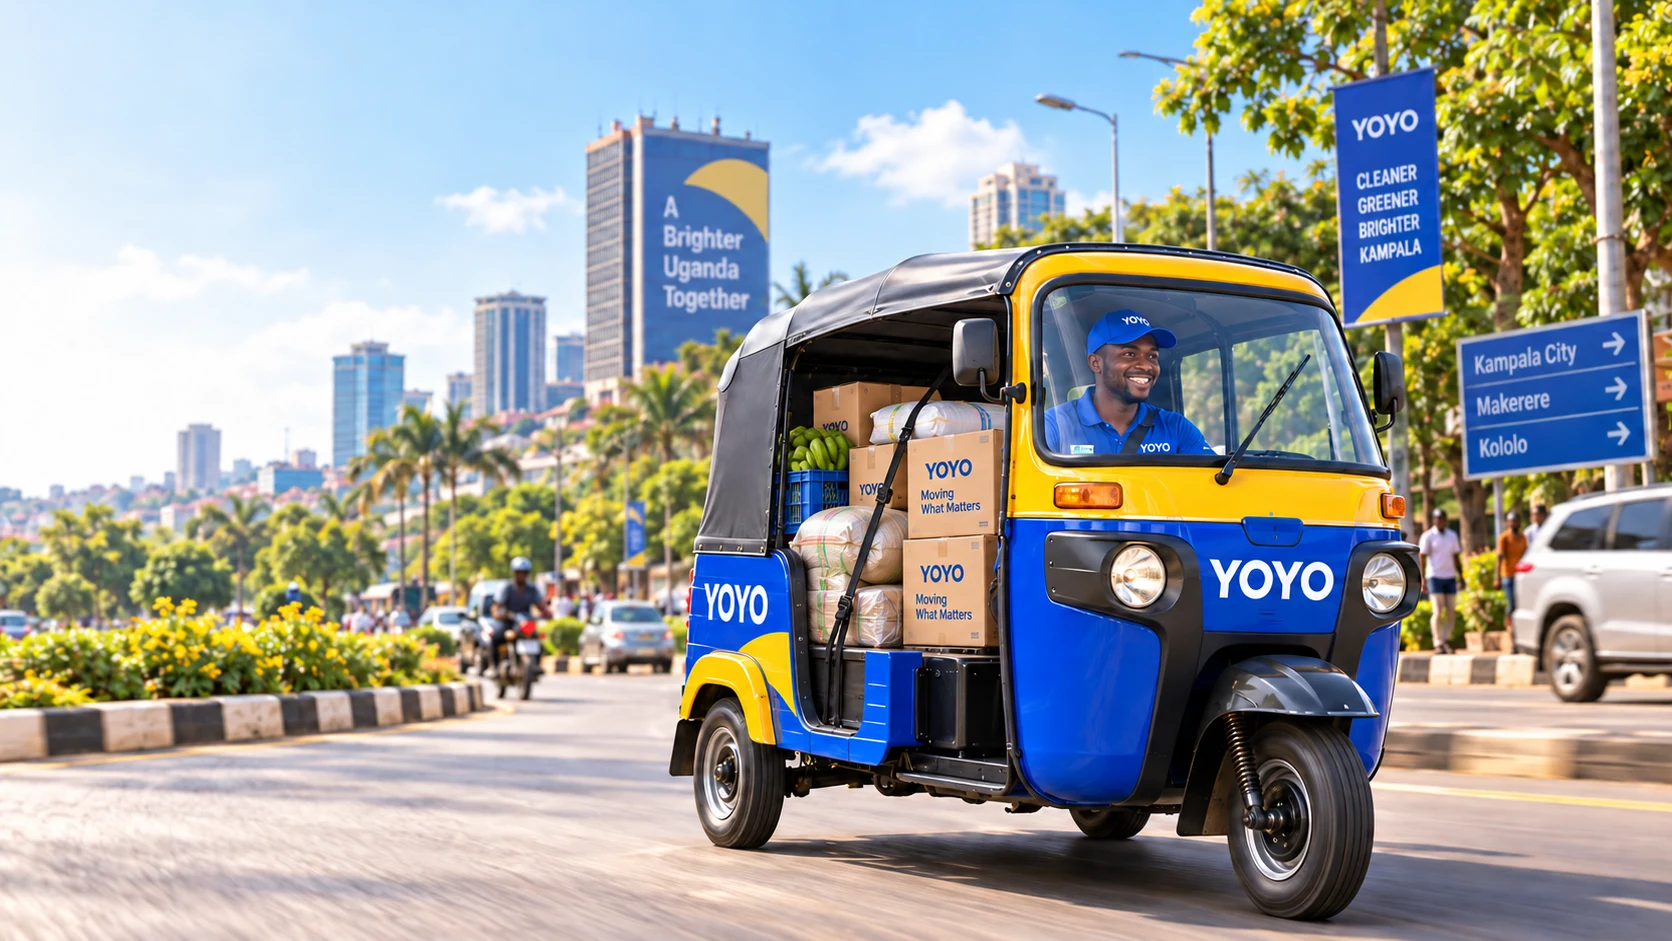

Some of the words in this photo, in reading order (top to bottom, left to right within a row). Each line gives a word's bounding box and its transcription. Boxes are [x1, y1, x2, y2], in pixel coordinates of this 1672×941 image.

[1352, 109, 1418, 141] YOYO
[1356, 164, 1417, 190] CLEANER
[663, 196, 678, 218] A
[1357, 189, 1418, 215] GREENER
[1358, 213, 1420, 239] BRIGHTER
[663, 225, 744, 254] Brighter
[1359, 238, 1422, 264] KAMPALA
[663, 254, 740, 283] Uganda
[663, 285, 750, 314] Together
[1121, 315, 1150, 327] YOYO
[1474, 347, 1542, 377] Kampala
[1544, 342, 1577, 367] City
[1476, 393, 1550, 417] Makerere
[1140, 442, 1171, 453] YOYO
[1479, 435, 1528, 459] Kololo
[925, 458, 973, 480] YOYO
[920, 488, 955, 502] Moving
[920, 504, 945, 514] What
[946, 500, 981, 512] Matters
[919, 563, 965, 583] YOYO
[1209, 558, 1335, 601] YOYO
[704, 583, 769, 625] YOYO
[915, 593, 948, 608] Moving
[915, 609, 938, 620] What
[939, 607, 973, 620] Matters
